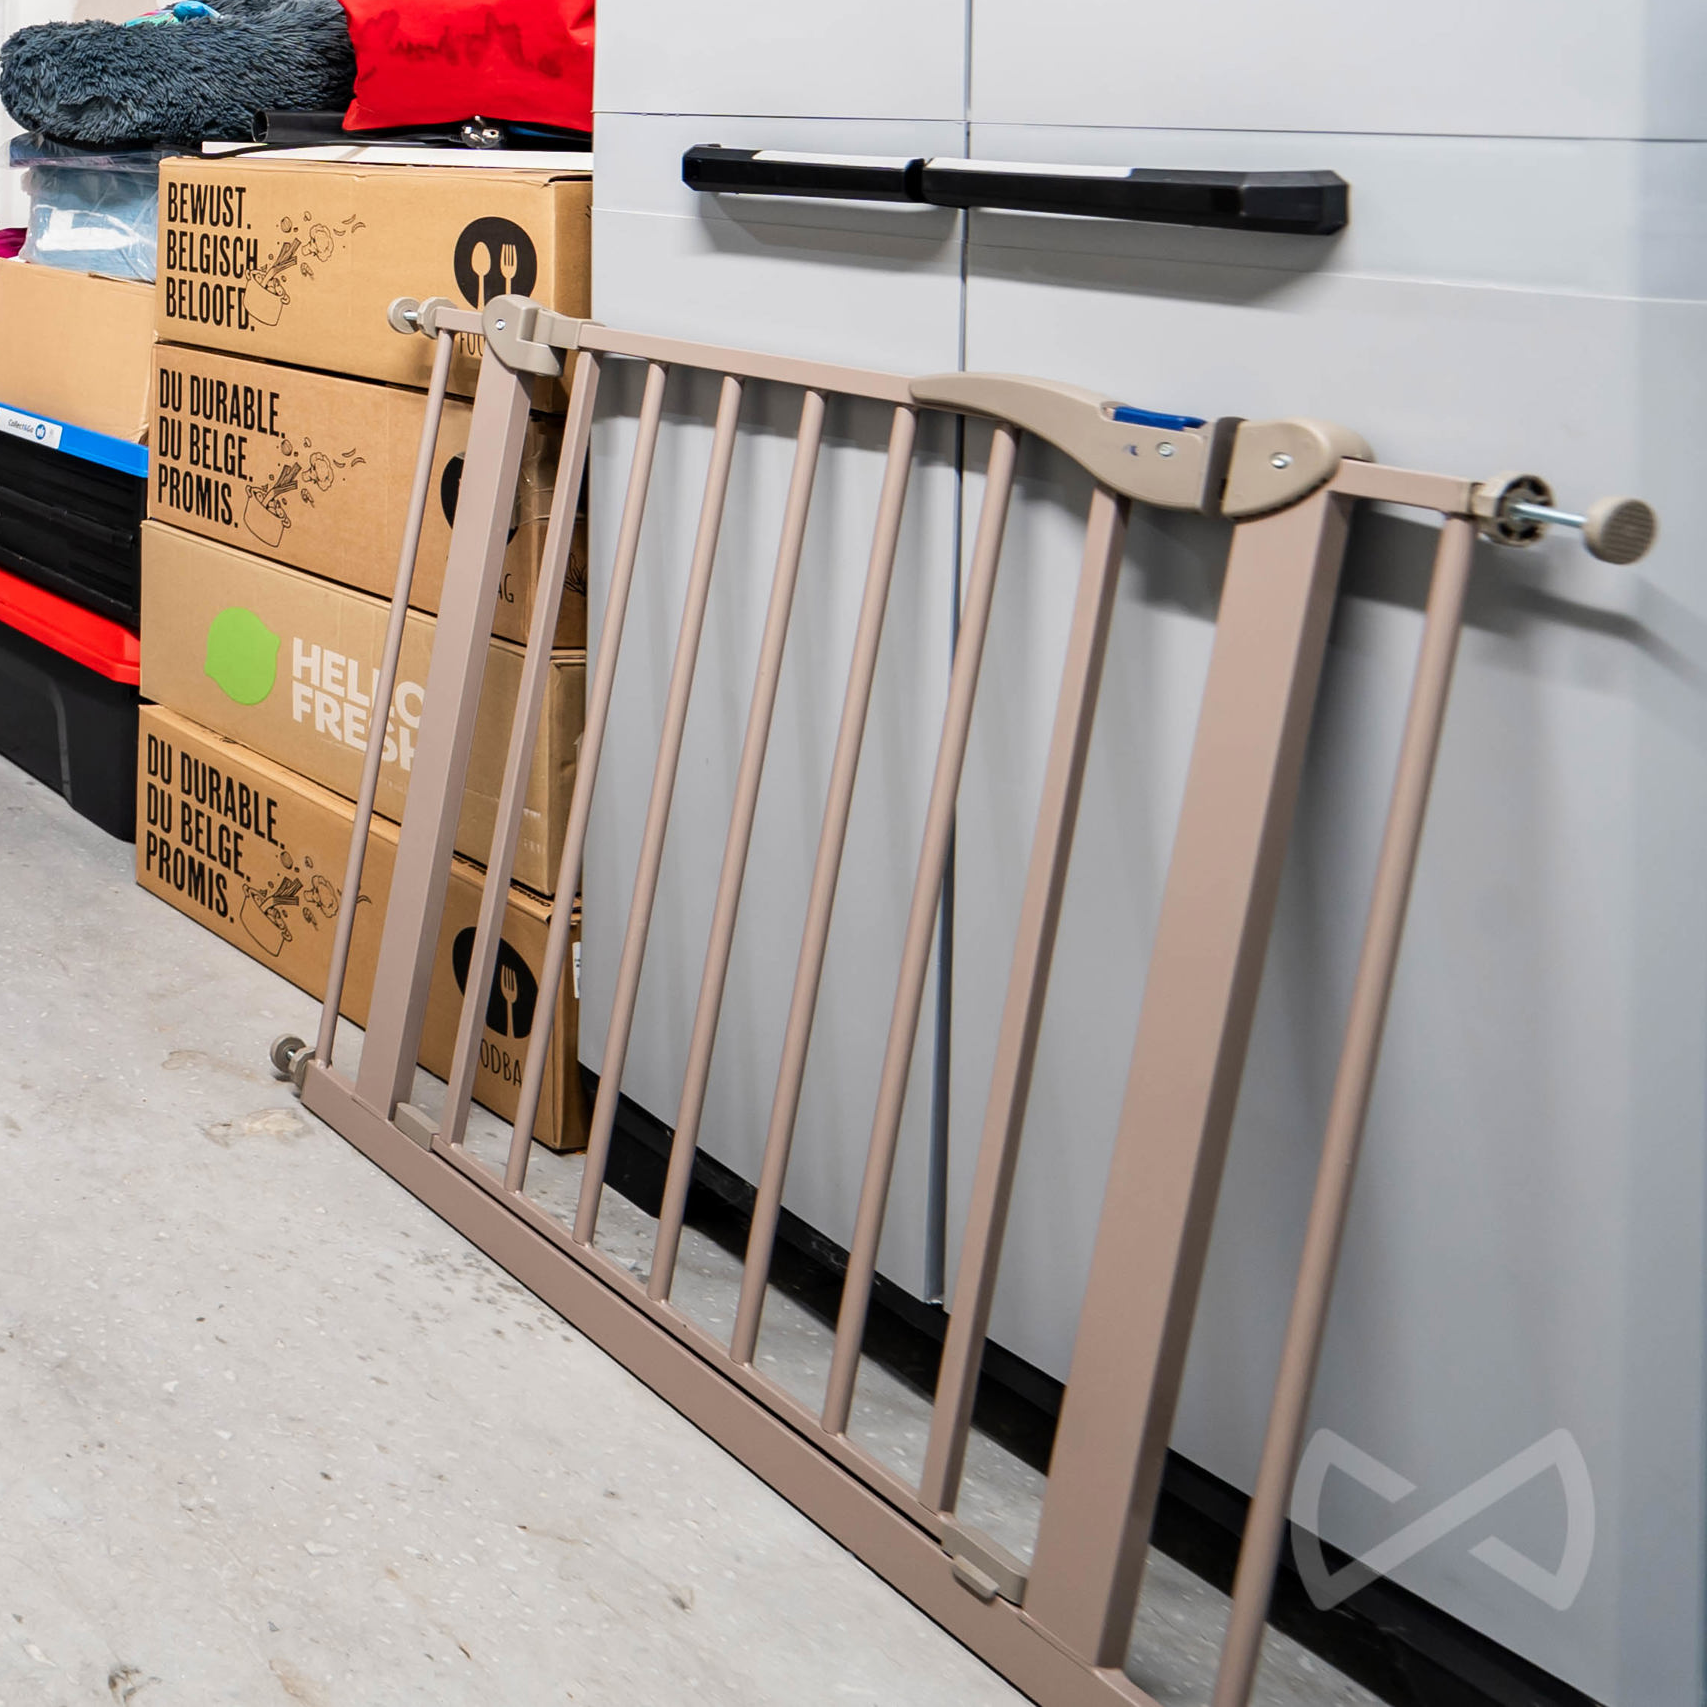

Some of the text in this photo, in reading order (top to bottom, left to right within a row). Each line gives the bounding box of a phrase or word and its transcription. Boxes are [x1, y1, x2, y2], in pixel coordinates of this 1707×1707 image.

[166, 181, 252, 230] BEWUST.
[165, 276, 256, 332] BELOOFD.
[159, 367, 286, 439] DU DURABLE.
[158, 415, 254, 482] DU BELGE.
[157, 463, 239, 529] PROMIS.
[147, 733, 286, 849] DU DURABLE.
[146, 781, 251, 882] DU BELGE.
[146, 830, 235, 923] PROMIS.
